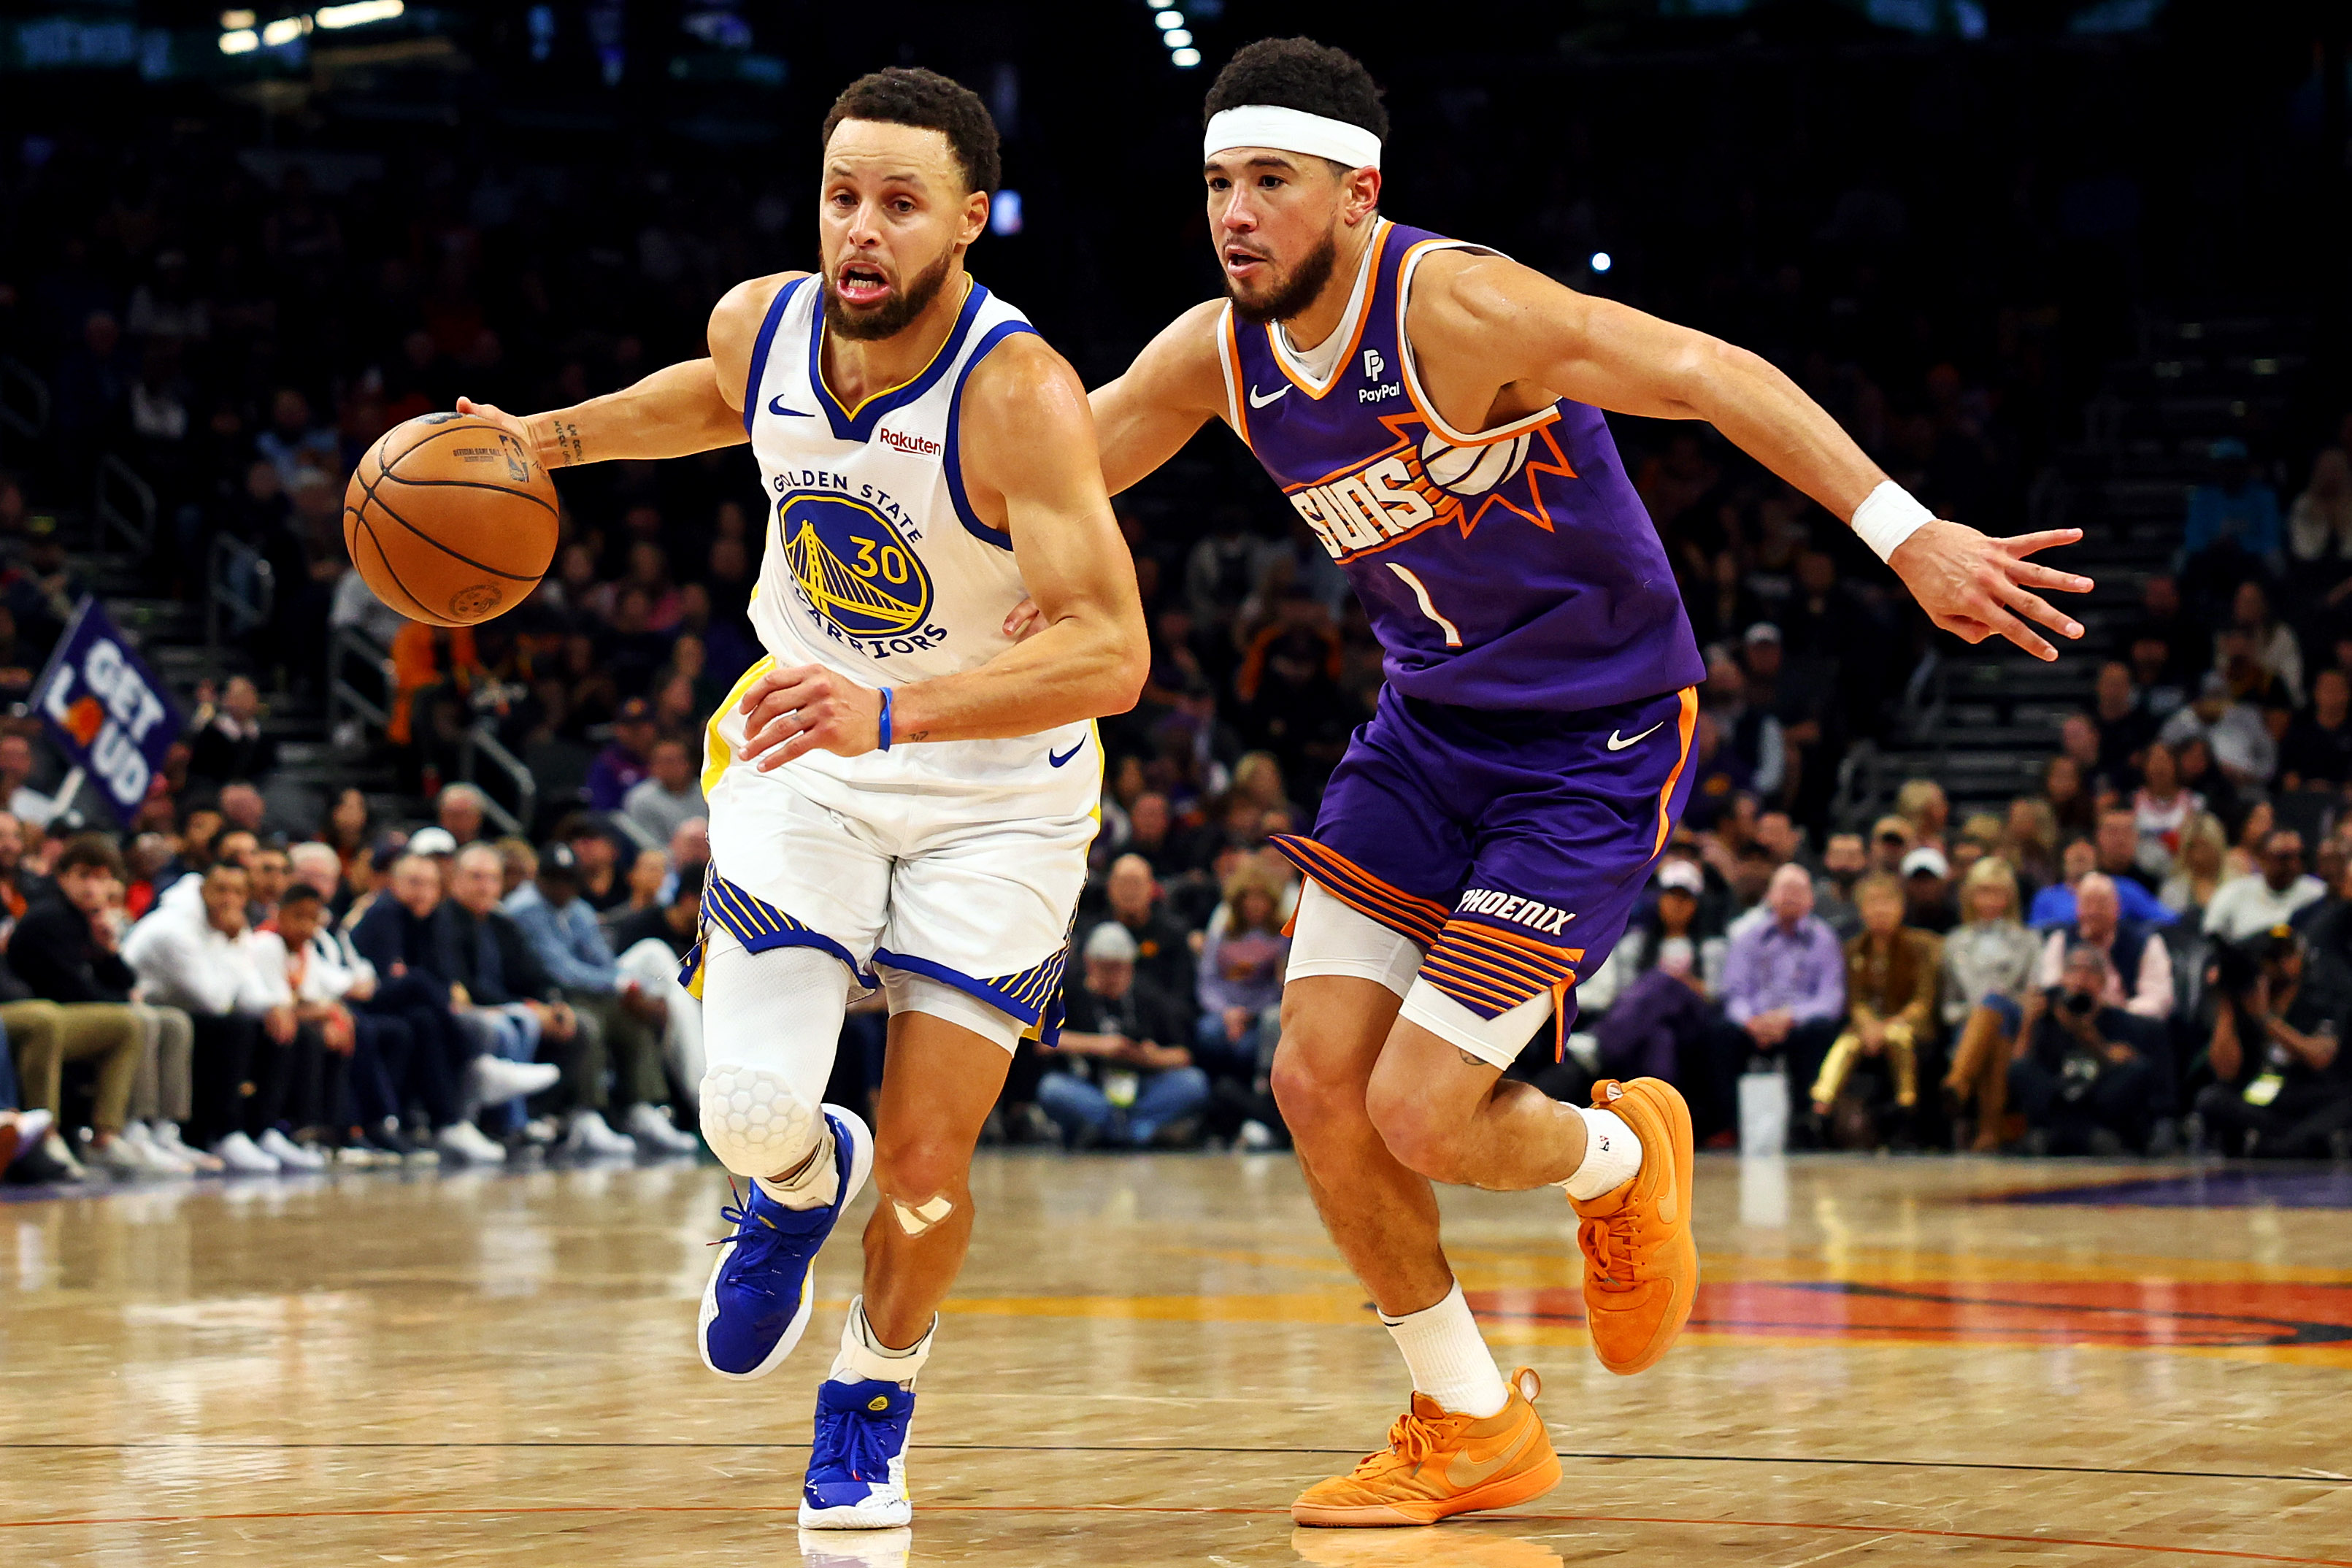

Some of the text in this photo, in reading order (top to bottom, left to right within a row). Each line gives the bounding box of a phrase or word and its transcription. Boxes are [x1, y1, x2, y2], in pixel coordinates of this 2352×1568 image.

[1358, 381, 1400, 403] PayPal
[880, 428, 941, 456] Rakuten
[773, 470, 923, 544] GOLDEN STATE
[1289, 456, 1434, 558] SUNS
[849, 535, 909, 585] 30
[1386, 562, 1463, 647] 1
[85, 637, 166, 744] GET
[44, 660, 149, 805] LUD
[1454, 888, 1577, 937] PHOENIX
